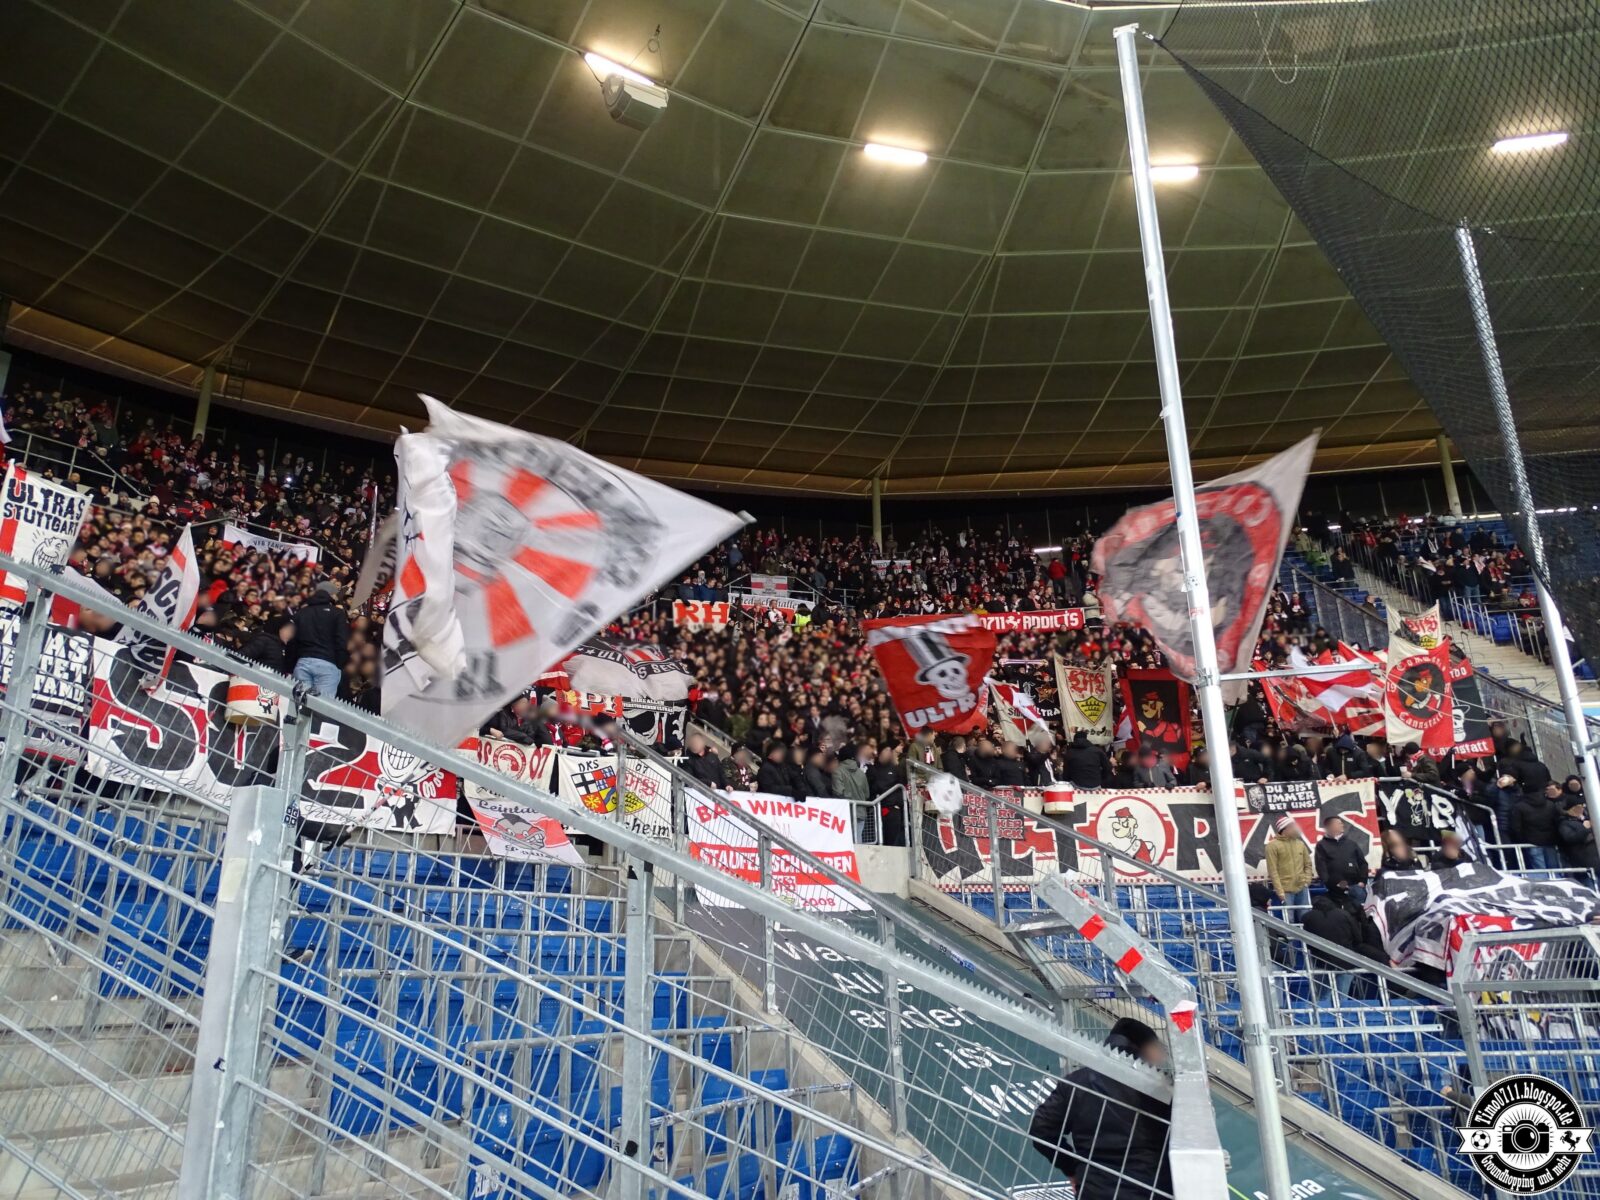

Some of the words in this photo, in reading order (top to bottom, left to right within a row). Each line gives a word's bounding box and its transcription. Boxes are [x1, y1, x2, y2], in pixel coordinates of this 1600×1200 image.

[6, 477, 86, 520] ULTRAS
[3, 502, 79, 537] STUTTGART
[674, 602, 730, 624] RH
[1022, 611, 1080, 630] ADDICTS
[577, 759, 600, 773] DKS
[1265, 785, 1283, 794] DU
[1287, 781, 1314, 793] BIST
[1266, 790, 1316, 803] IMMER
[1268, 802, 1288, 811] BEI
[1291, 799, 1318, 809] UNS!
[747, 799, 847, 835] WIMPFEN
[800, 896, 836, 907] 2008
